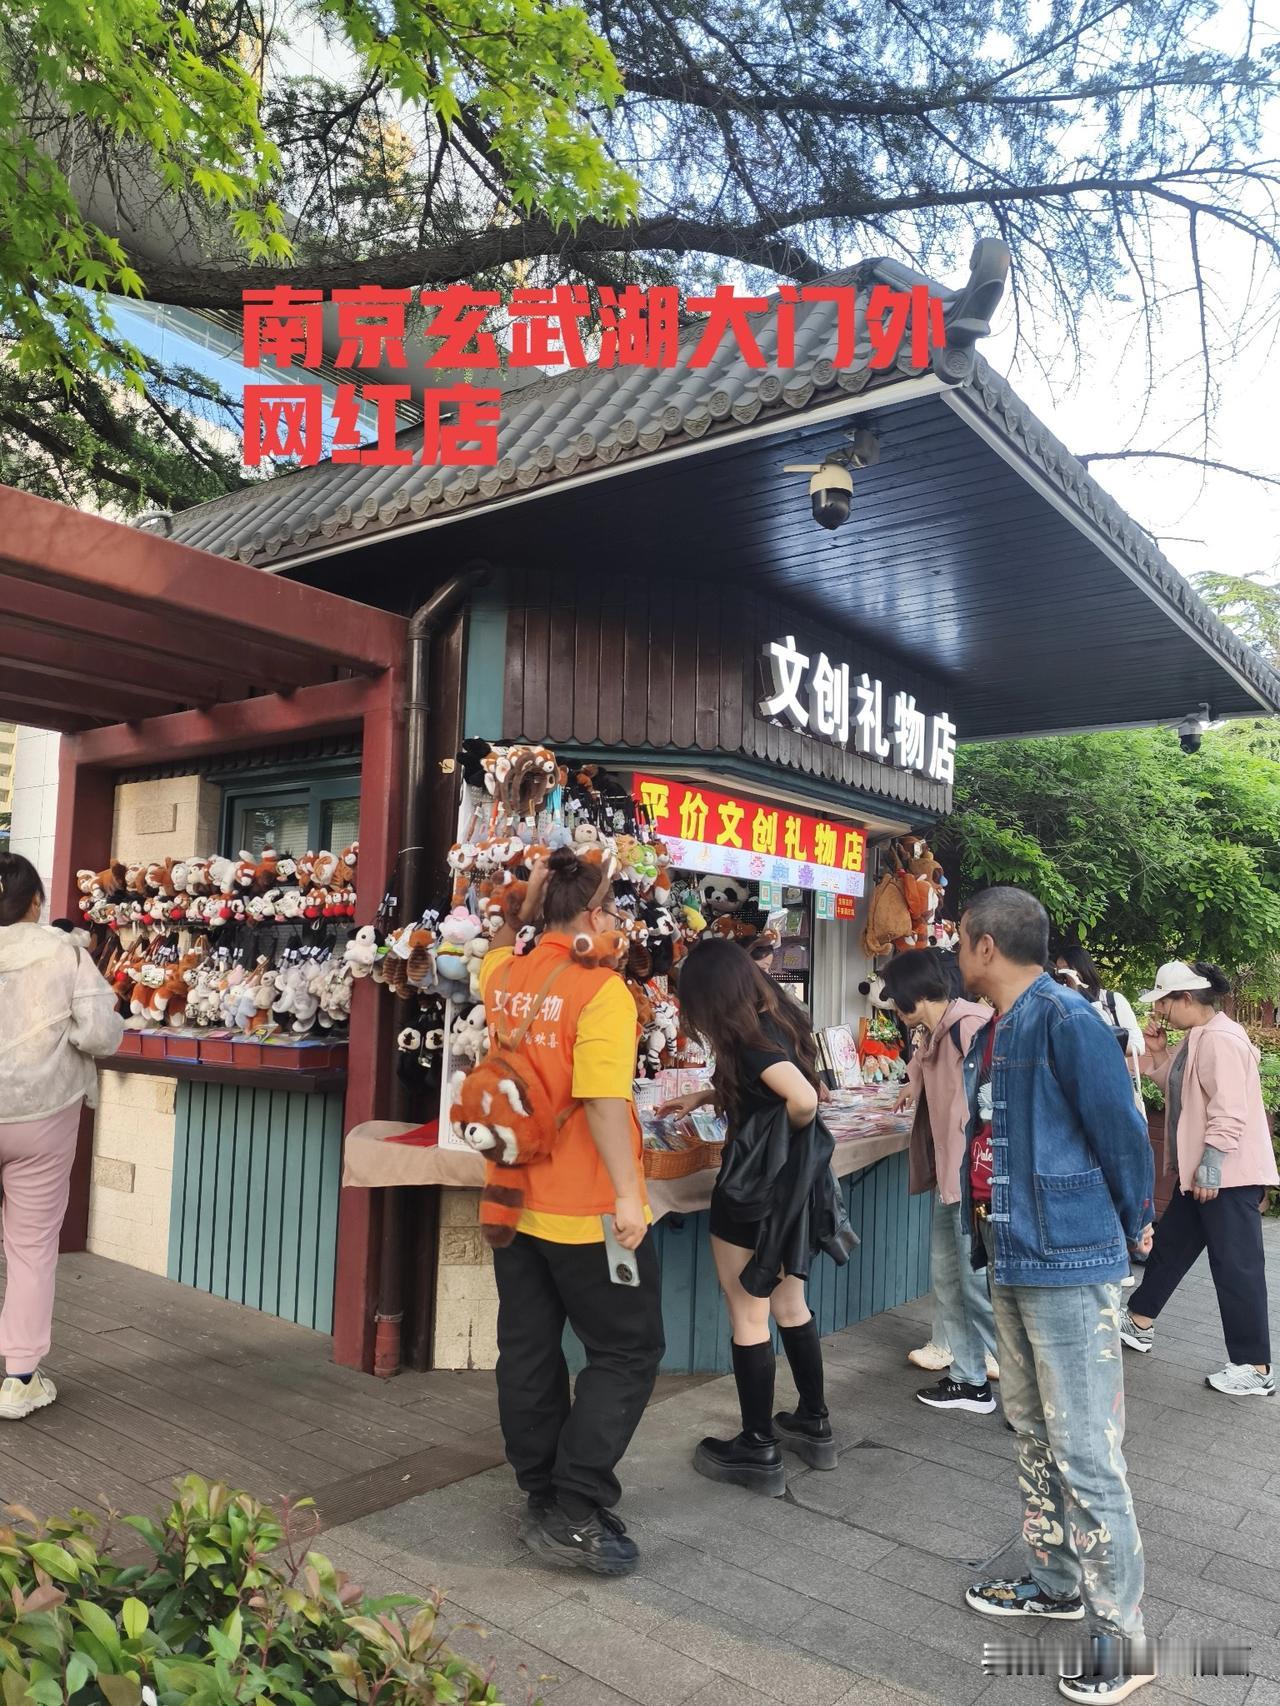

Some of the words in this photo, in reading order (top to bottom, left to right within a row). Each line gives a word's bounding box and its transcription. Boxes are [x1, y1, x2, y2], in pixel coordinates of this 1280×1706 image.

[758, 635, 956, 784] 文创礼物店
[640, 782, 863, 871] 平价文创礼物店
